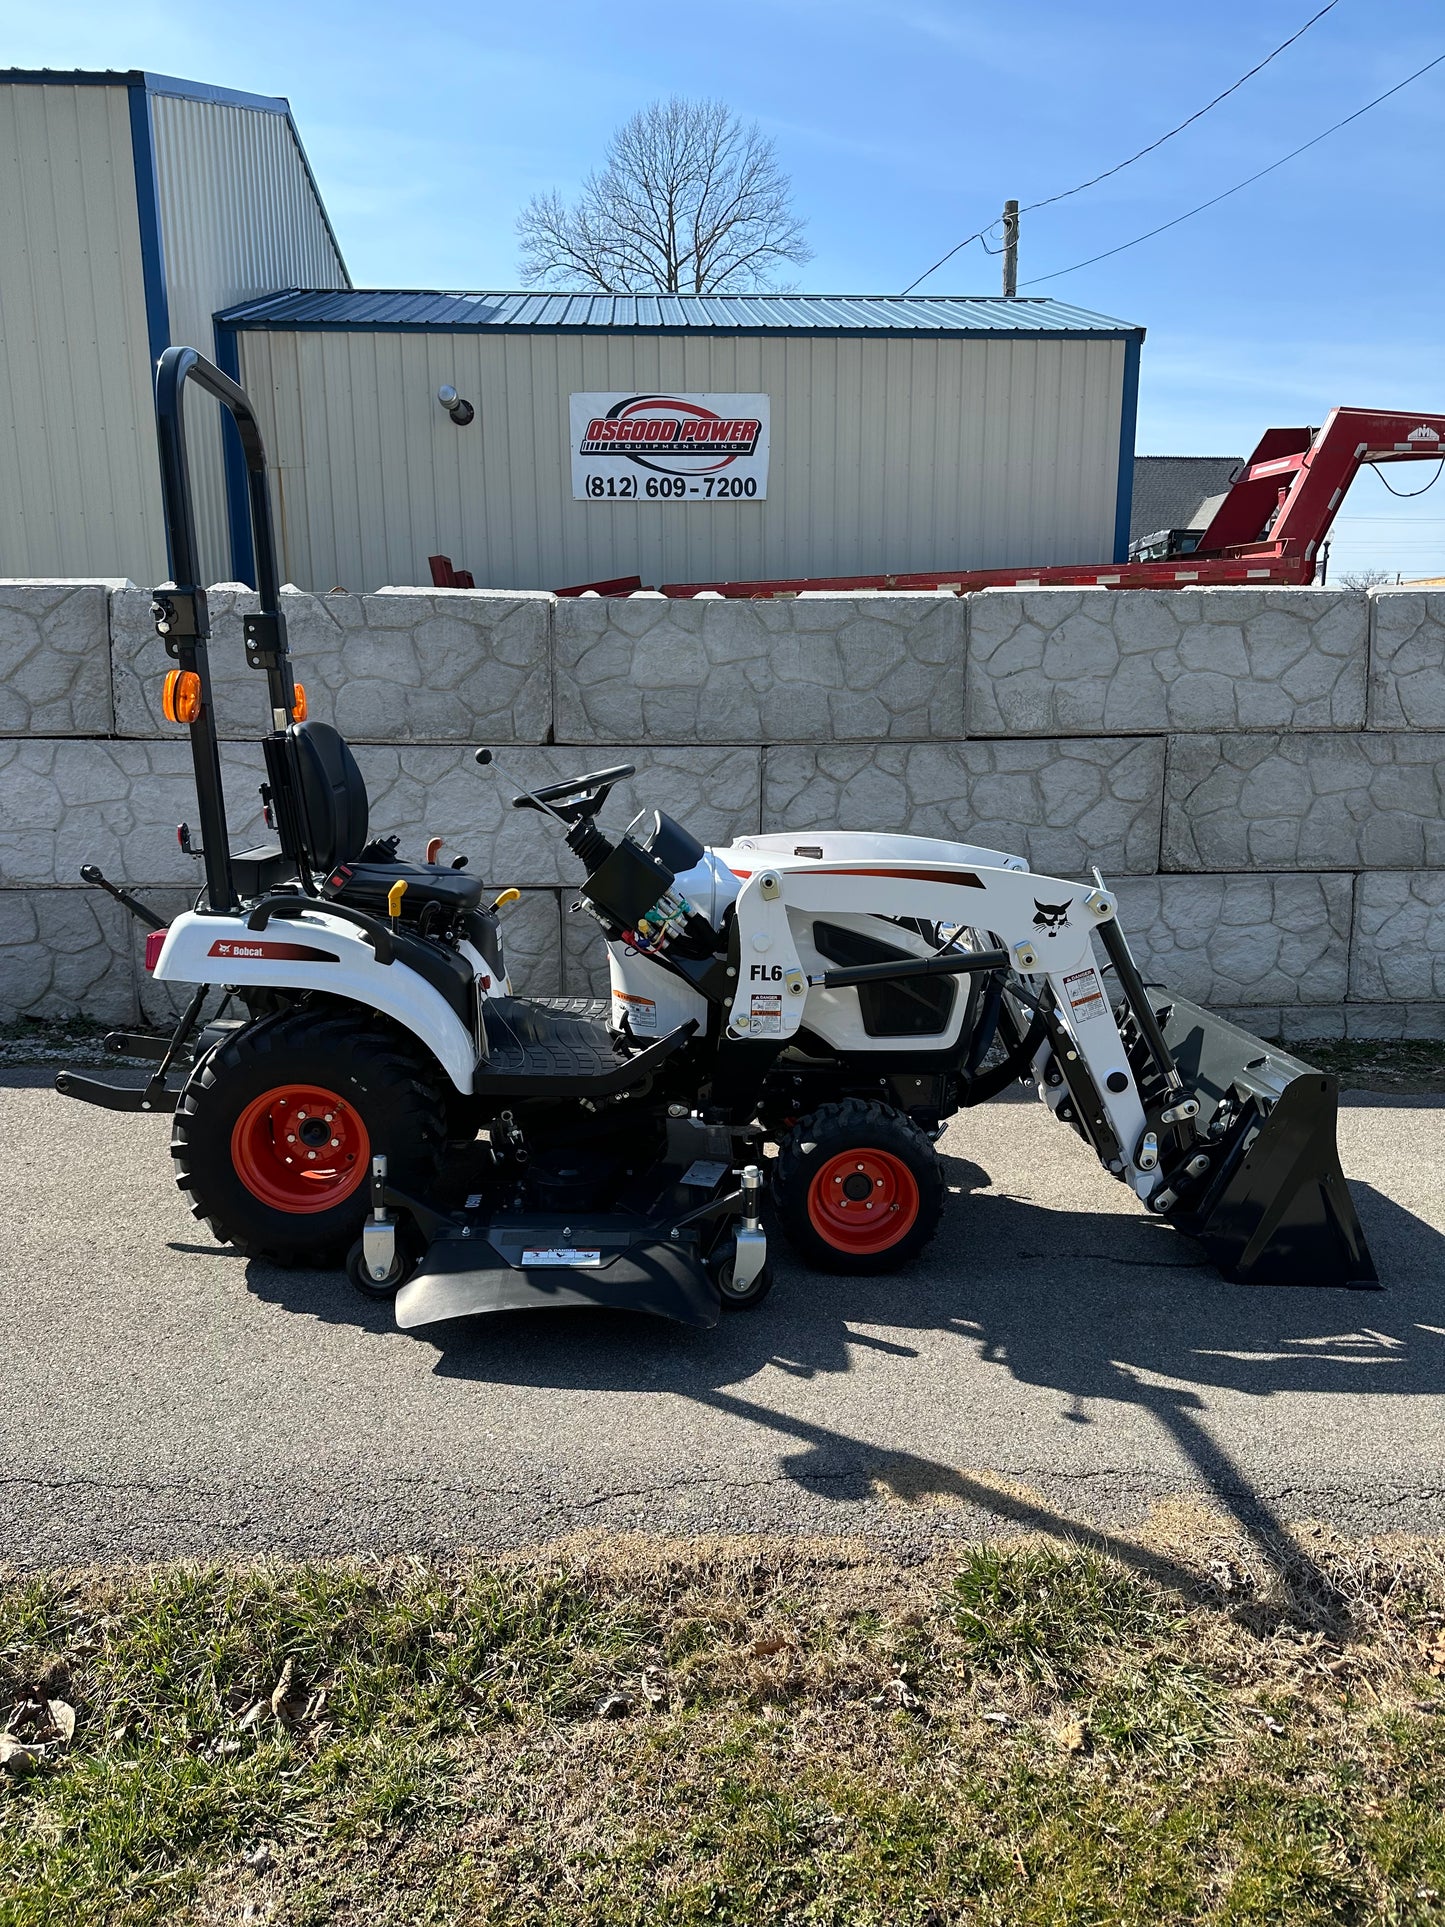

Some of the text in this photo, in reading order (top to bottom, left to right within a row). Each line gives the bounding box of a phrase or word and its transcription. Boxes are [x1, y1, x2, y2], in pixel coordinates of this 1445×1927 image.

[586, 420, 759, 441] OSGOOD POWER
[586, 475, 637, 498] (812)
[233, 946, 263, 957] Bobcat
[751, 965, 782, 981] FL6
[1071, 970, 1092, 980] DANGER
